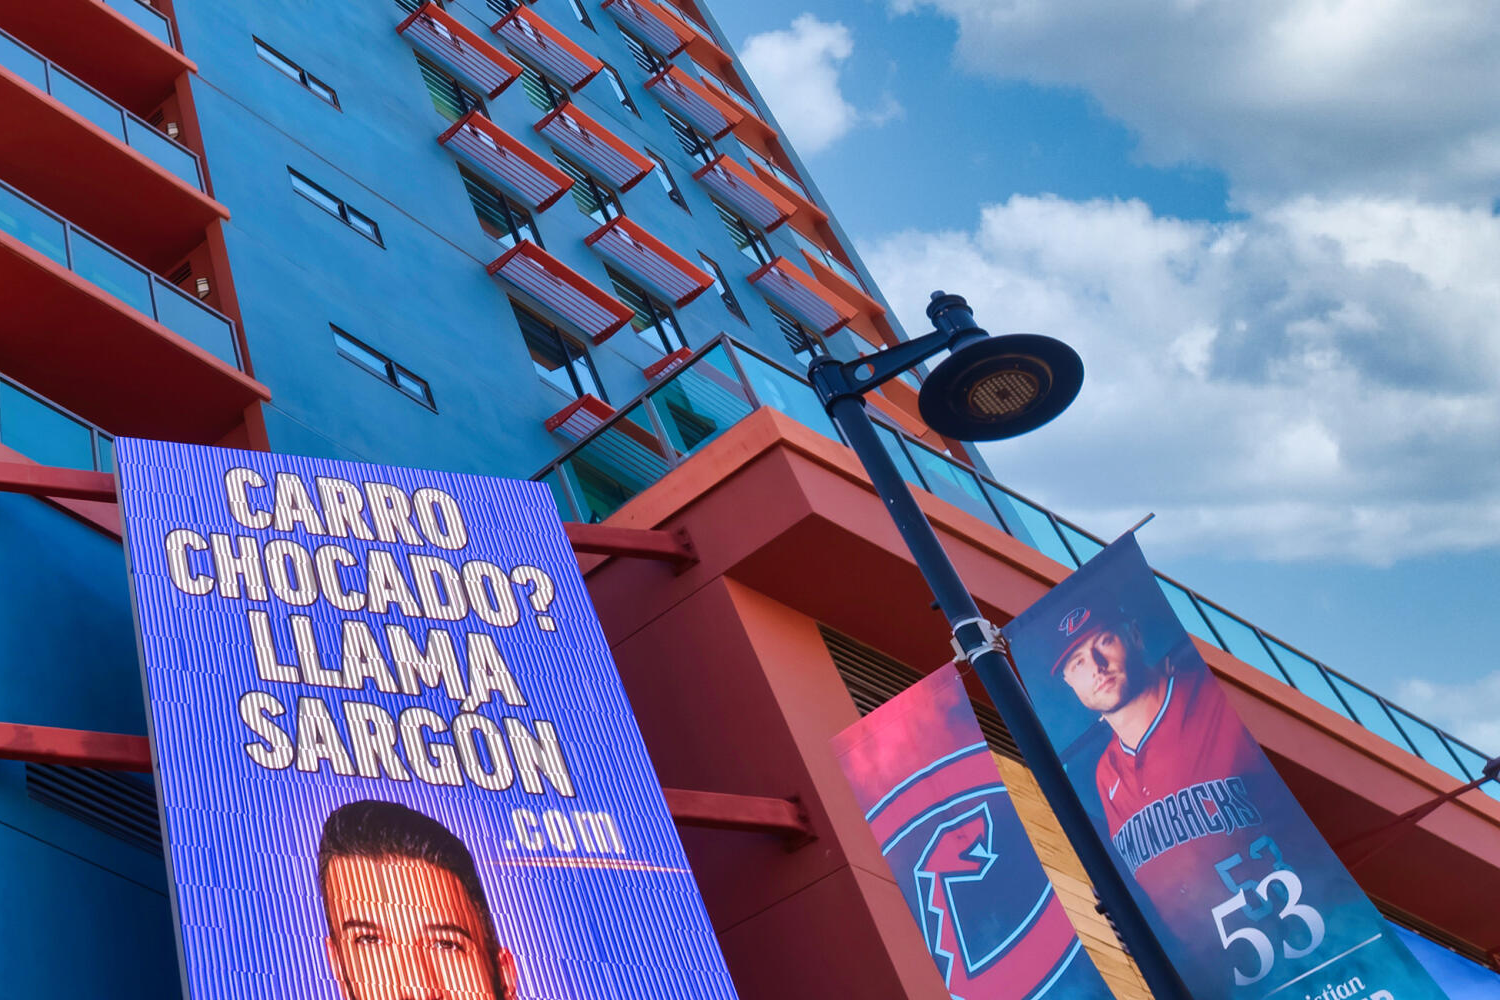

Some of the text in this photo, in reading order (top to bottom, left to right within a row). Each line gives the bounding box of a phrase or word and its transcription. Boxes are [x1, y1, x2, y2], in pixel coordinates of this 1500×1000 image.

[223, 466, 469, 551] CARRO
[164, 528, 557, 632] CHOCADO?
[247, 610, 527, 707] LLAMA
[238, 690, 577, 798] SARGÓN
[505, 807, 626, 856] .com
[1211, 869, 1326, 986] 53
